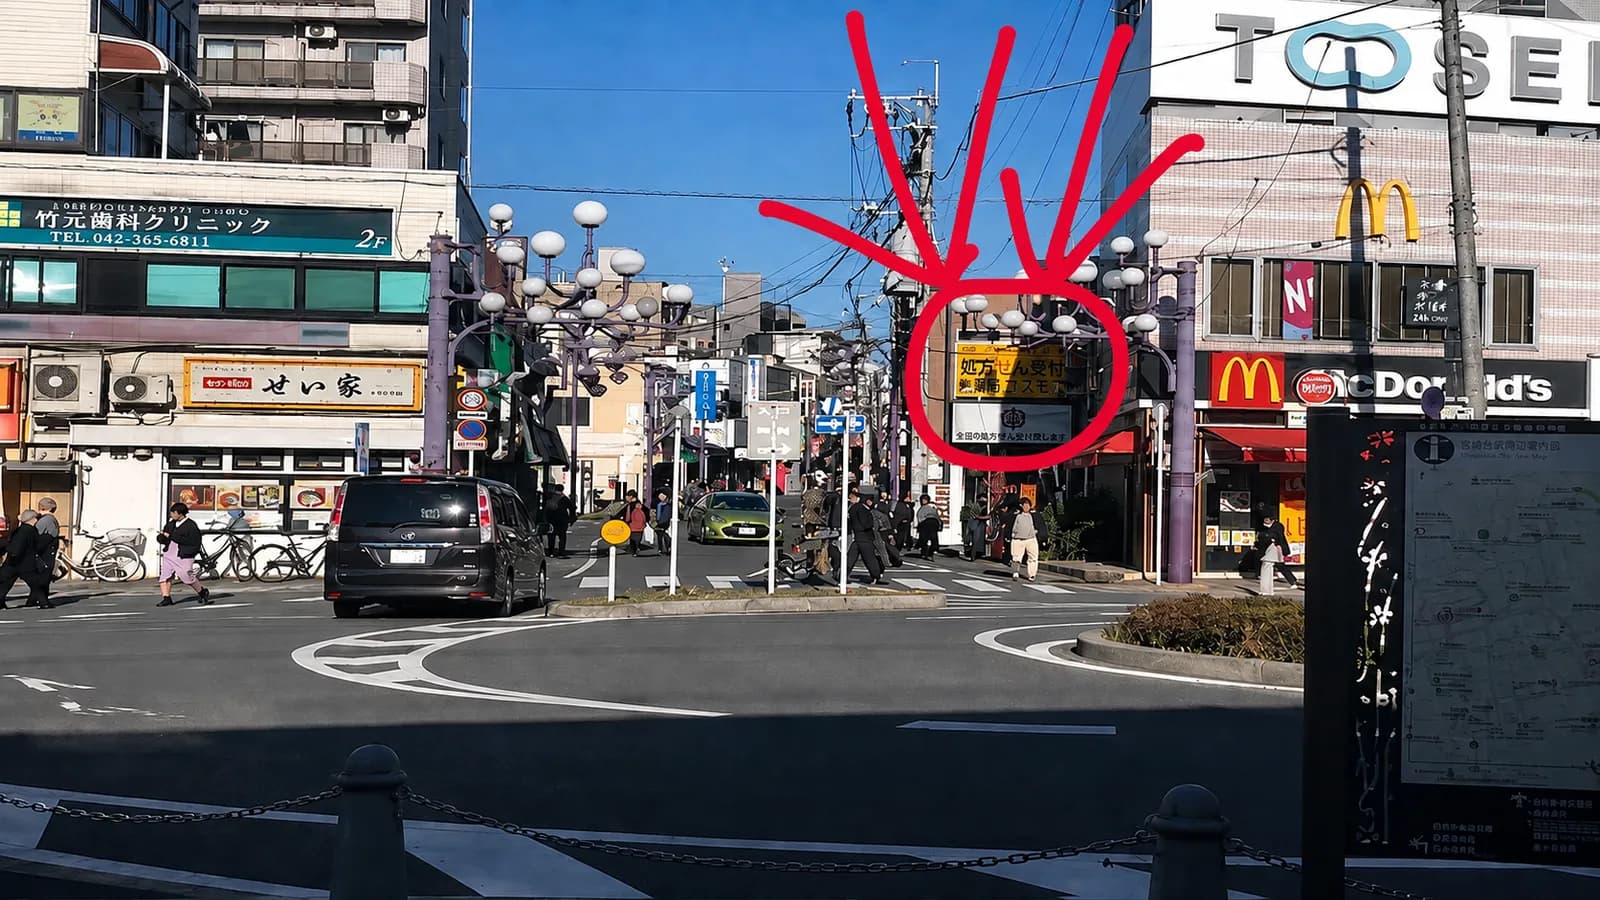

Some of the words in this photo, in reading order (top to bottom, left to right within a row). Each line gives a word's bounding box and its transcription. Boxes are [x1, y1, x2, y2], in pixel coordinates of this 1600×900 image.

[35, 209, 272, 235] 竹元歯科クリニック
[355, 229, 388, 249] 2F
[961, 357, 1065, 377] 処方せん受付
[262, 373, 363, 398] せい家
[1310, 369, 1553, 402] cDold's
